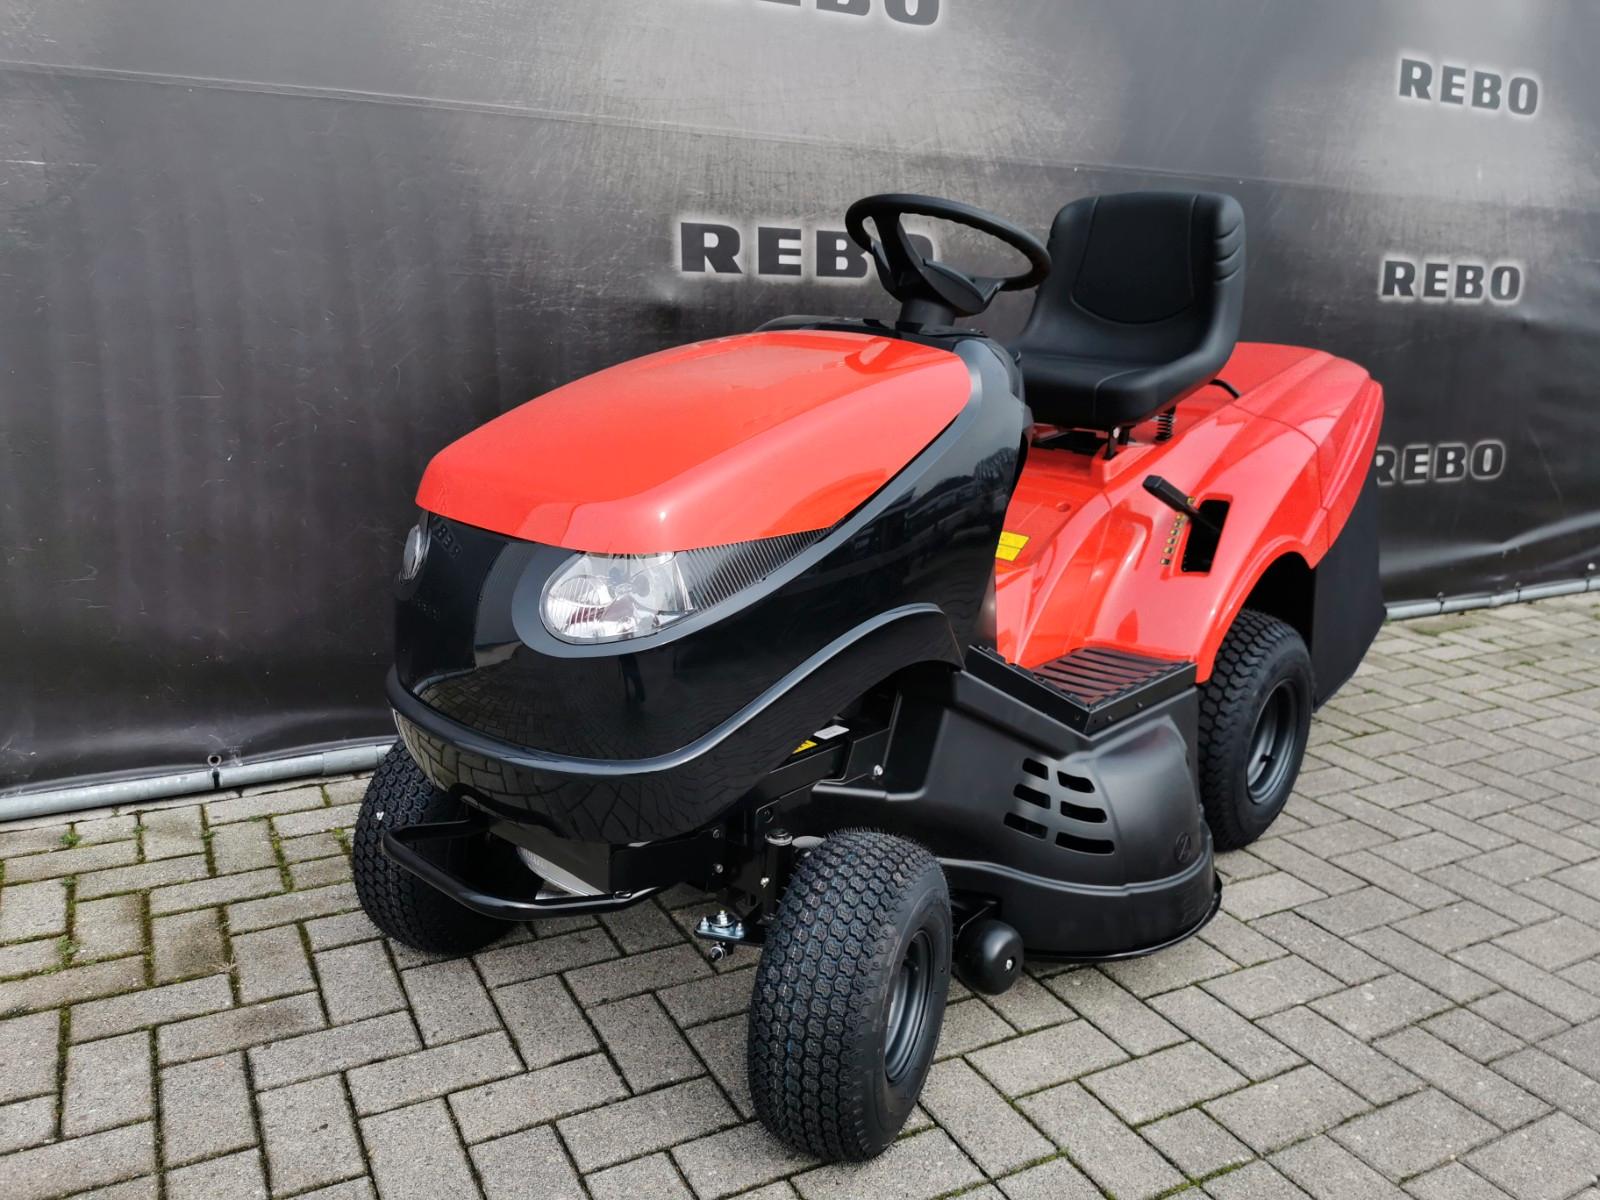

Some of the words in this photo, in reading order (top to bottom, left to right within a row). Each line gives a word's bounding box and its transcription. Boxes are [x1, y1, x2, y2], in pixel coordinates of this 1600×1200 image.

[1399, 58, 1538, 115] REBO
[1382, 260, 1520, 300] REBO
[1375, 440, 1504, 484] REBO
